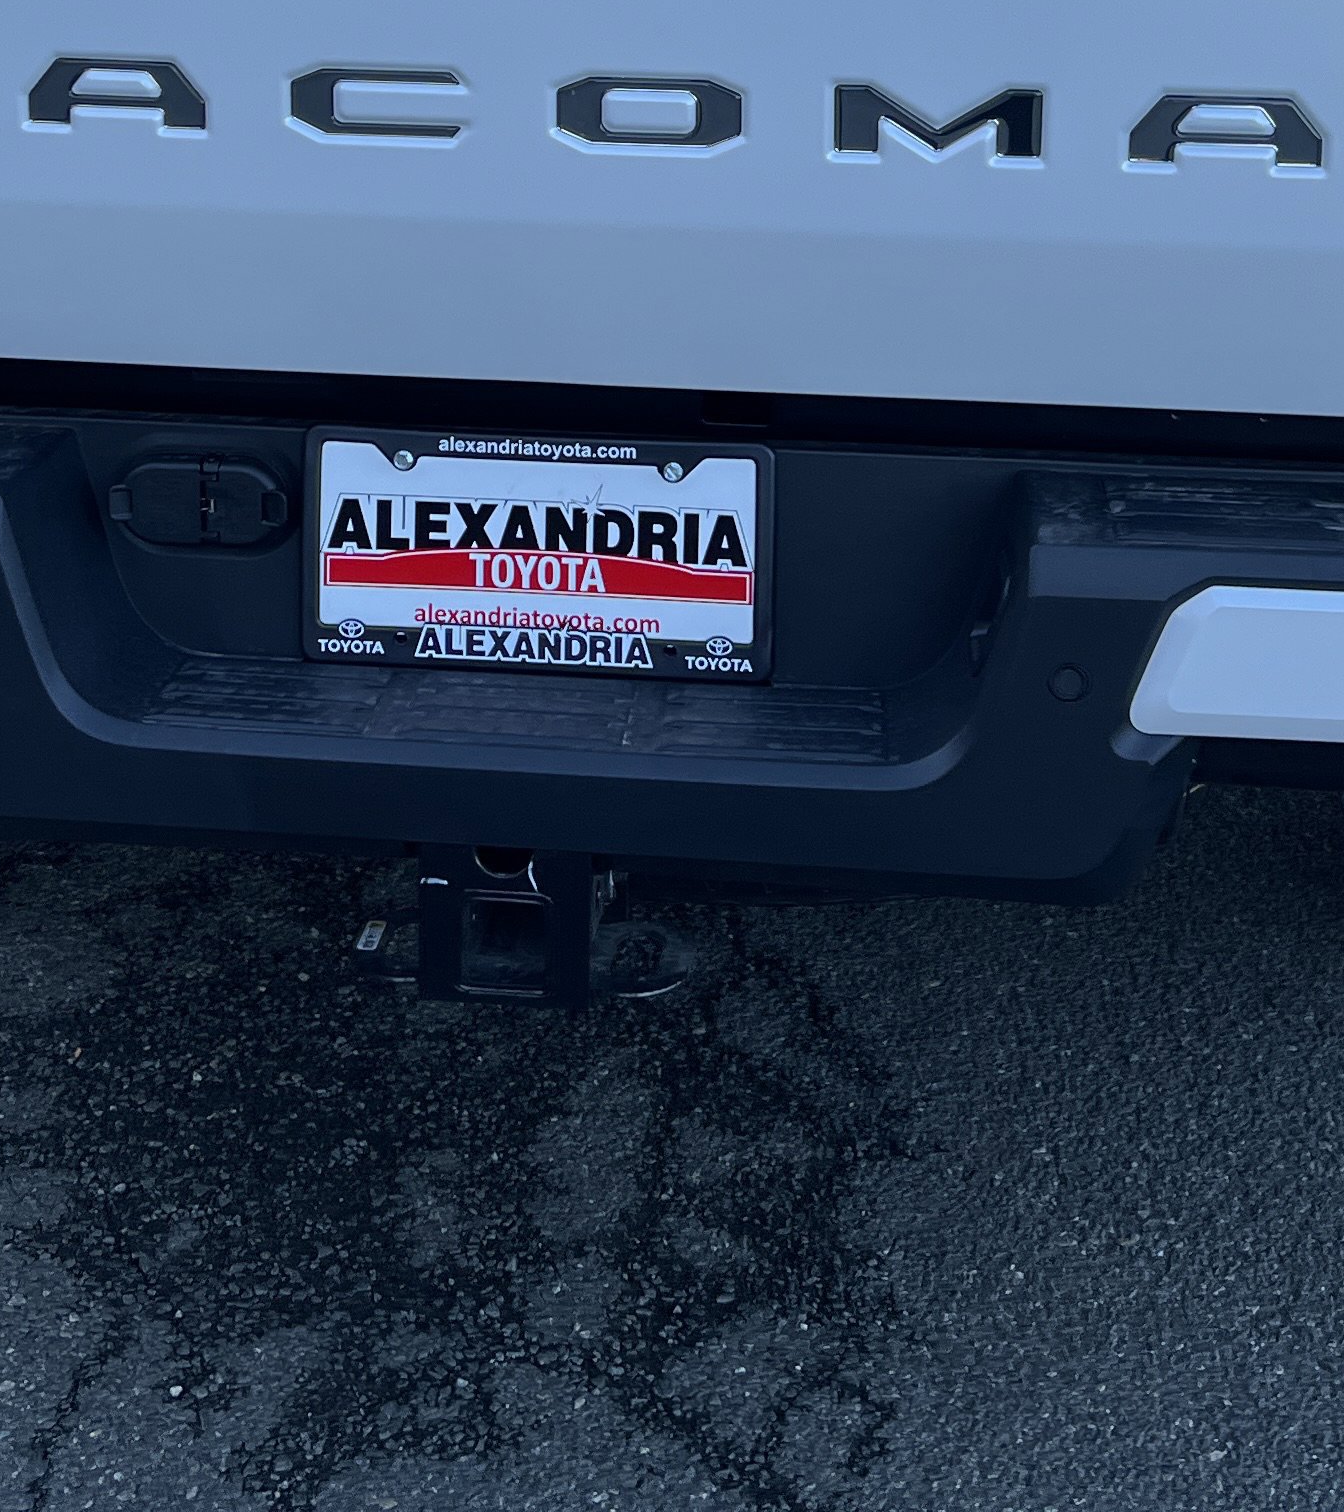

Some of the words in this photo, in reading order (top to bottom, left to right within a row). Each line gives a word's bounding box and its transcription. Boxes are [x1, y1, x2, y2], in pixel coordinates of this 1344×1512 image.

[438, 436, 637, 460] alexandriatoyota.com
[327, 497, 748, 568] ALEXANDRIA
[469, 552, 606, 593] TOYOTA
[414, 603, 660, 633] alexandriatoyota.com
[317, 638, 385, 656] TOYOTA
[415, 624, 654, 668] ALEXANDRIA
[684, 655, 753, 673] TOYOTA
